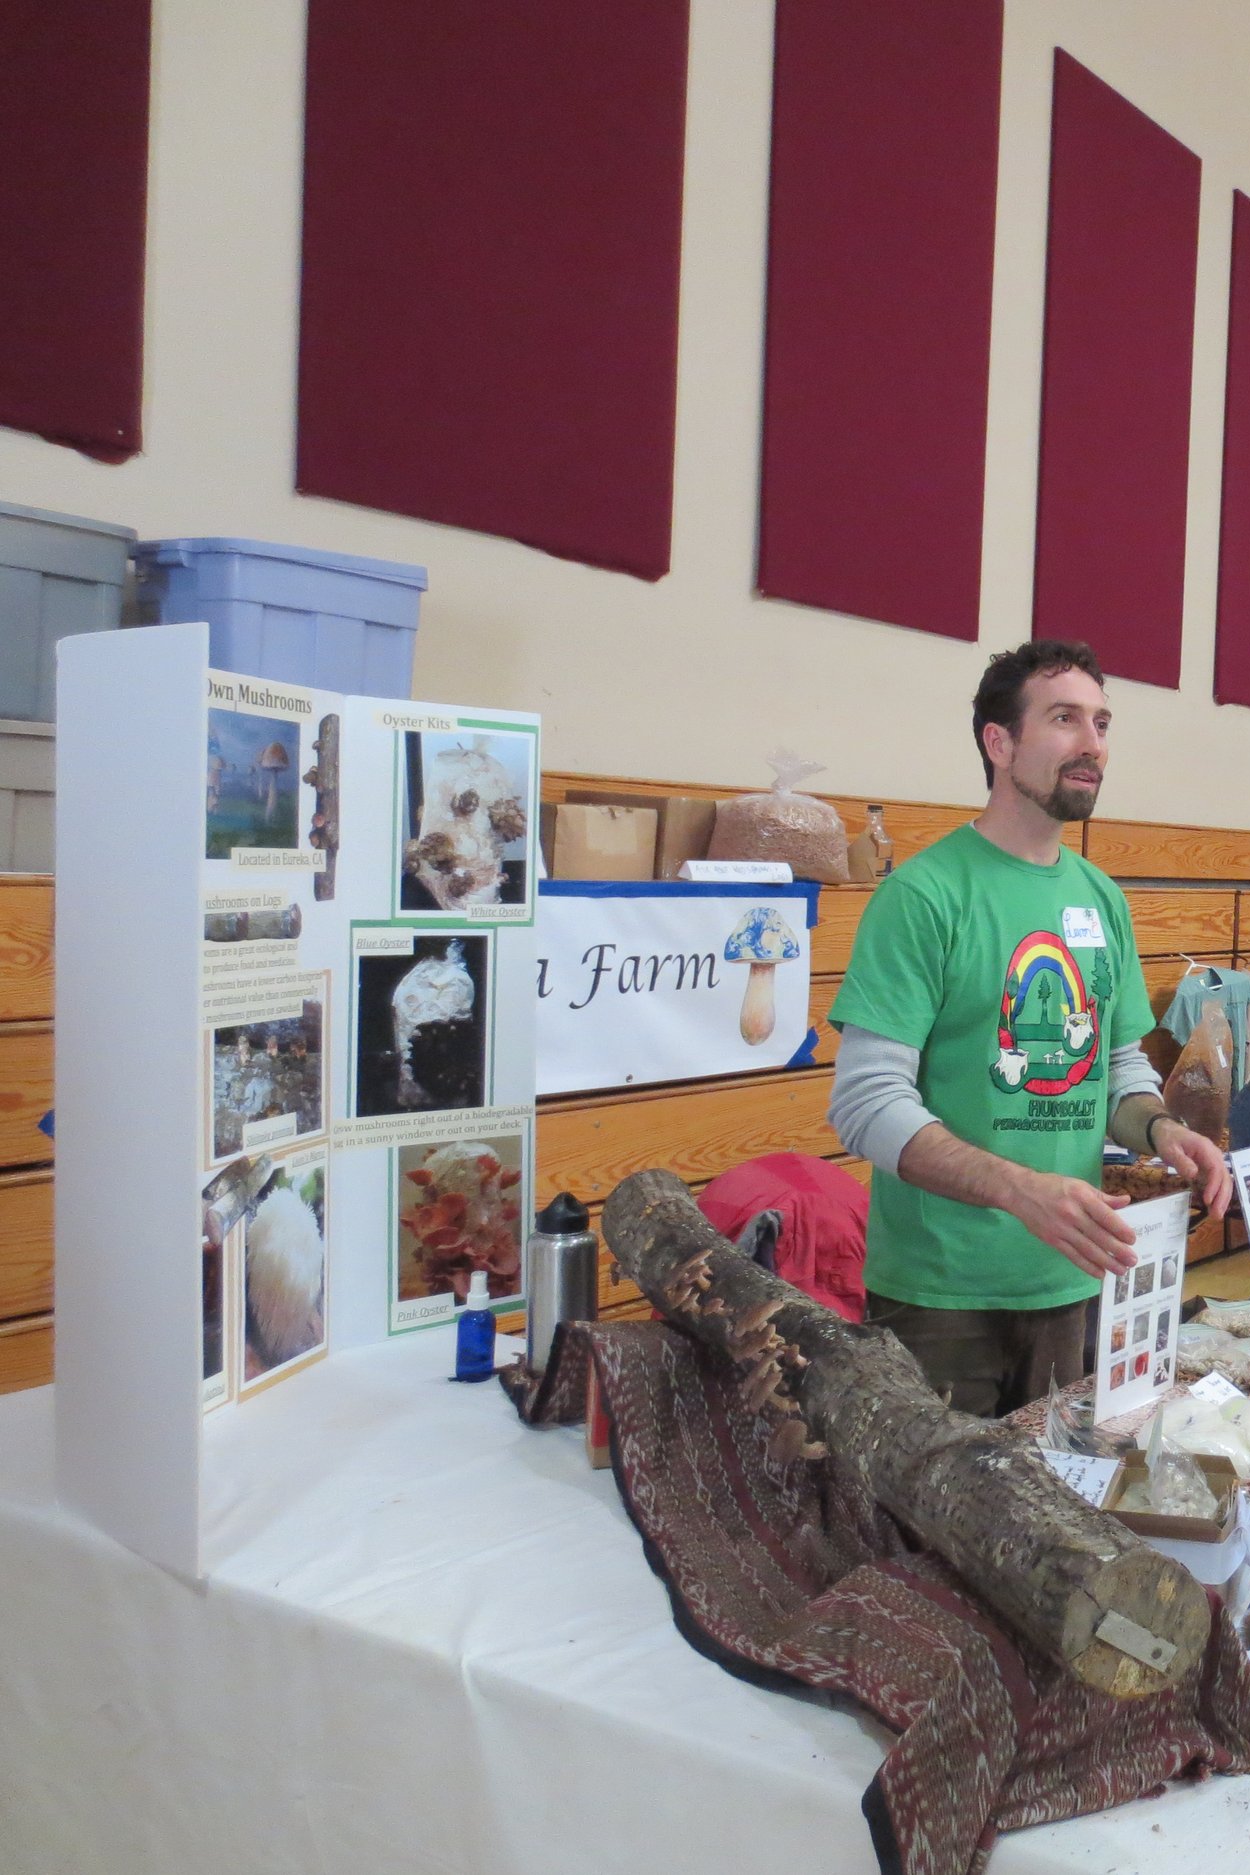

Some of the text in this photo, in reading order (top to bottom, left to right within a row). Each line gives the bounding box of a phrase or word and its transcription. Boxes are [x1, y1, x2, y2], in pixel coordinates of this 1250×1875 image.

[239, 683, 313, 714] Mushrooms
[383, 713, 451, 729] Oyster Kits
[238, 852, 271, 866] Located
[273, 853, 281, 865] in
[312, 853, 324, 865] CA
[205, 896, 249, 909] ushrooms
[263, 894, 283, 909] Logs
[470, 907, 527, 918] White Oyster
[356, 937, 411, 950] Blue Oyster
[569, 943, 721, 1010] Farm
[1028, 1099, 1097, 1118] HUMBOLDT
[355, 1118, 411, 1131] mushrooms
[413, 1115, 435, 1127] right
[437, 1115, 452, 1123] out
[453, 1112, 463, 1121] of
[472, 1106, 534, 1119] biodegradable
[346, 1137, 355, 1146] in
[365, 1134, 394, 1144] sunny
[396, 1128, 434, 1140] window
[435, 1127, 445, 1136] or
[447, 1126, 462, 1135] out
[464, 1125, 476, 1134] on
[477, 1122, 498, 1134] your
[397, 1304, 451, 1323] Pink Oyster
